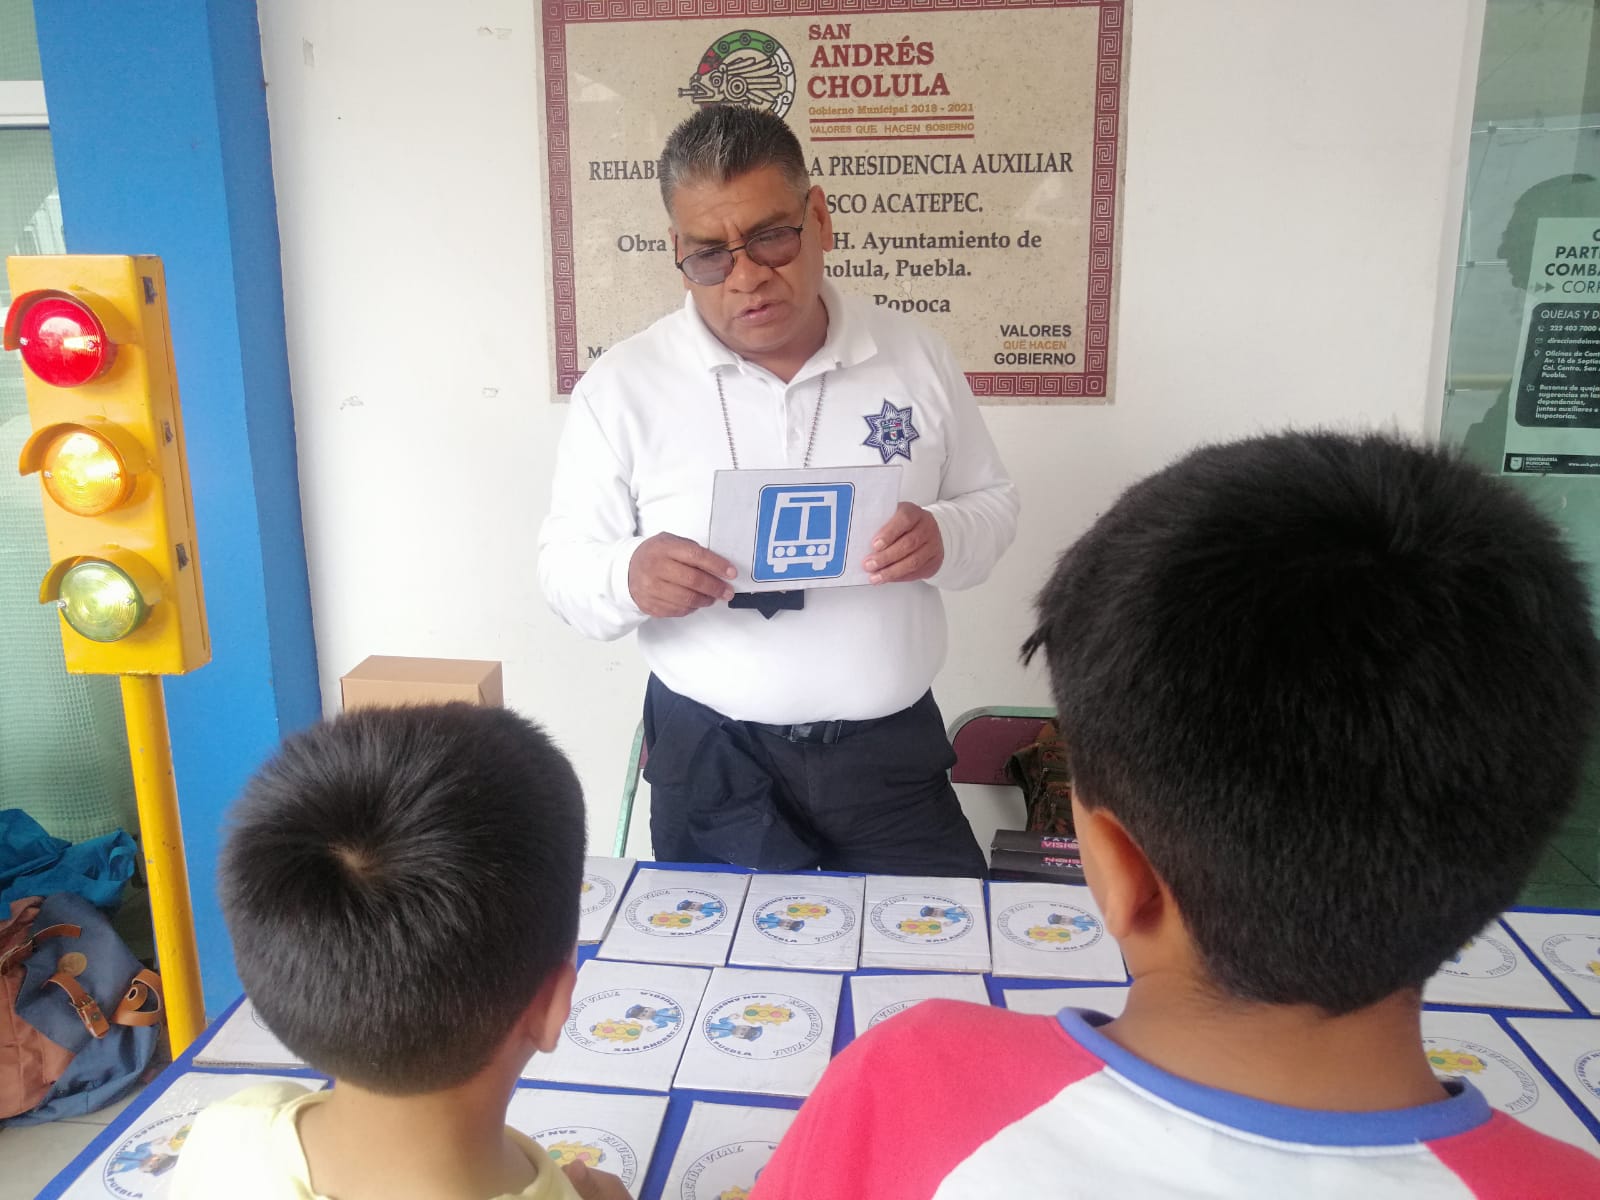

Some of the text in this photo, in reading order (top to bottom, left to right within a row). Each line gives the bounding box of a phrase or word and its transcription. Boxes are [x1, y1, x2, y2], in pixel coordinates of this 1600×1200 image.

[808, 23, 851, 40] SAN
[810, 35, 934, 68] ANDRÉS
[807, 72, 950, 99] CHOLULA
[808, 106, 854, 116] Gobierno
[857, 104, 908, 116] Municipal
[911, 103, 938, 114] 2018
[947, 102, 974, 113] 2021
[809, 122, 975, 135] VALORES QUE HACEN GOBIERNO
[588, 159, 662, 181] REHABI
[828, 154, 967, 177] PRESIDENCIA
[972, 152, 1074, 174] AUXILIAR
[826, 192, 984, 214] SCO ACATEPEC.
[617, 229, 1042, 255] Obra H. Ayuntamiento de
[1555, 245, 1600, 259] PART
[895, 257, 972, 277] Puebla.
[1541, 309, 1600, 319] QUEJAS Y D
[999, 324, 1072, 338] VALORES
[1003, 340, 1067, 350] QUE HACEN
[993, 352, 1076, 366] GOBIERNO
[1577, 358, 1600, 366] Septie
[1043, 841, 1081, 850] VISIO
